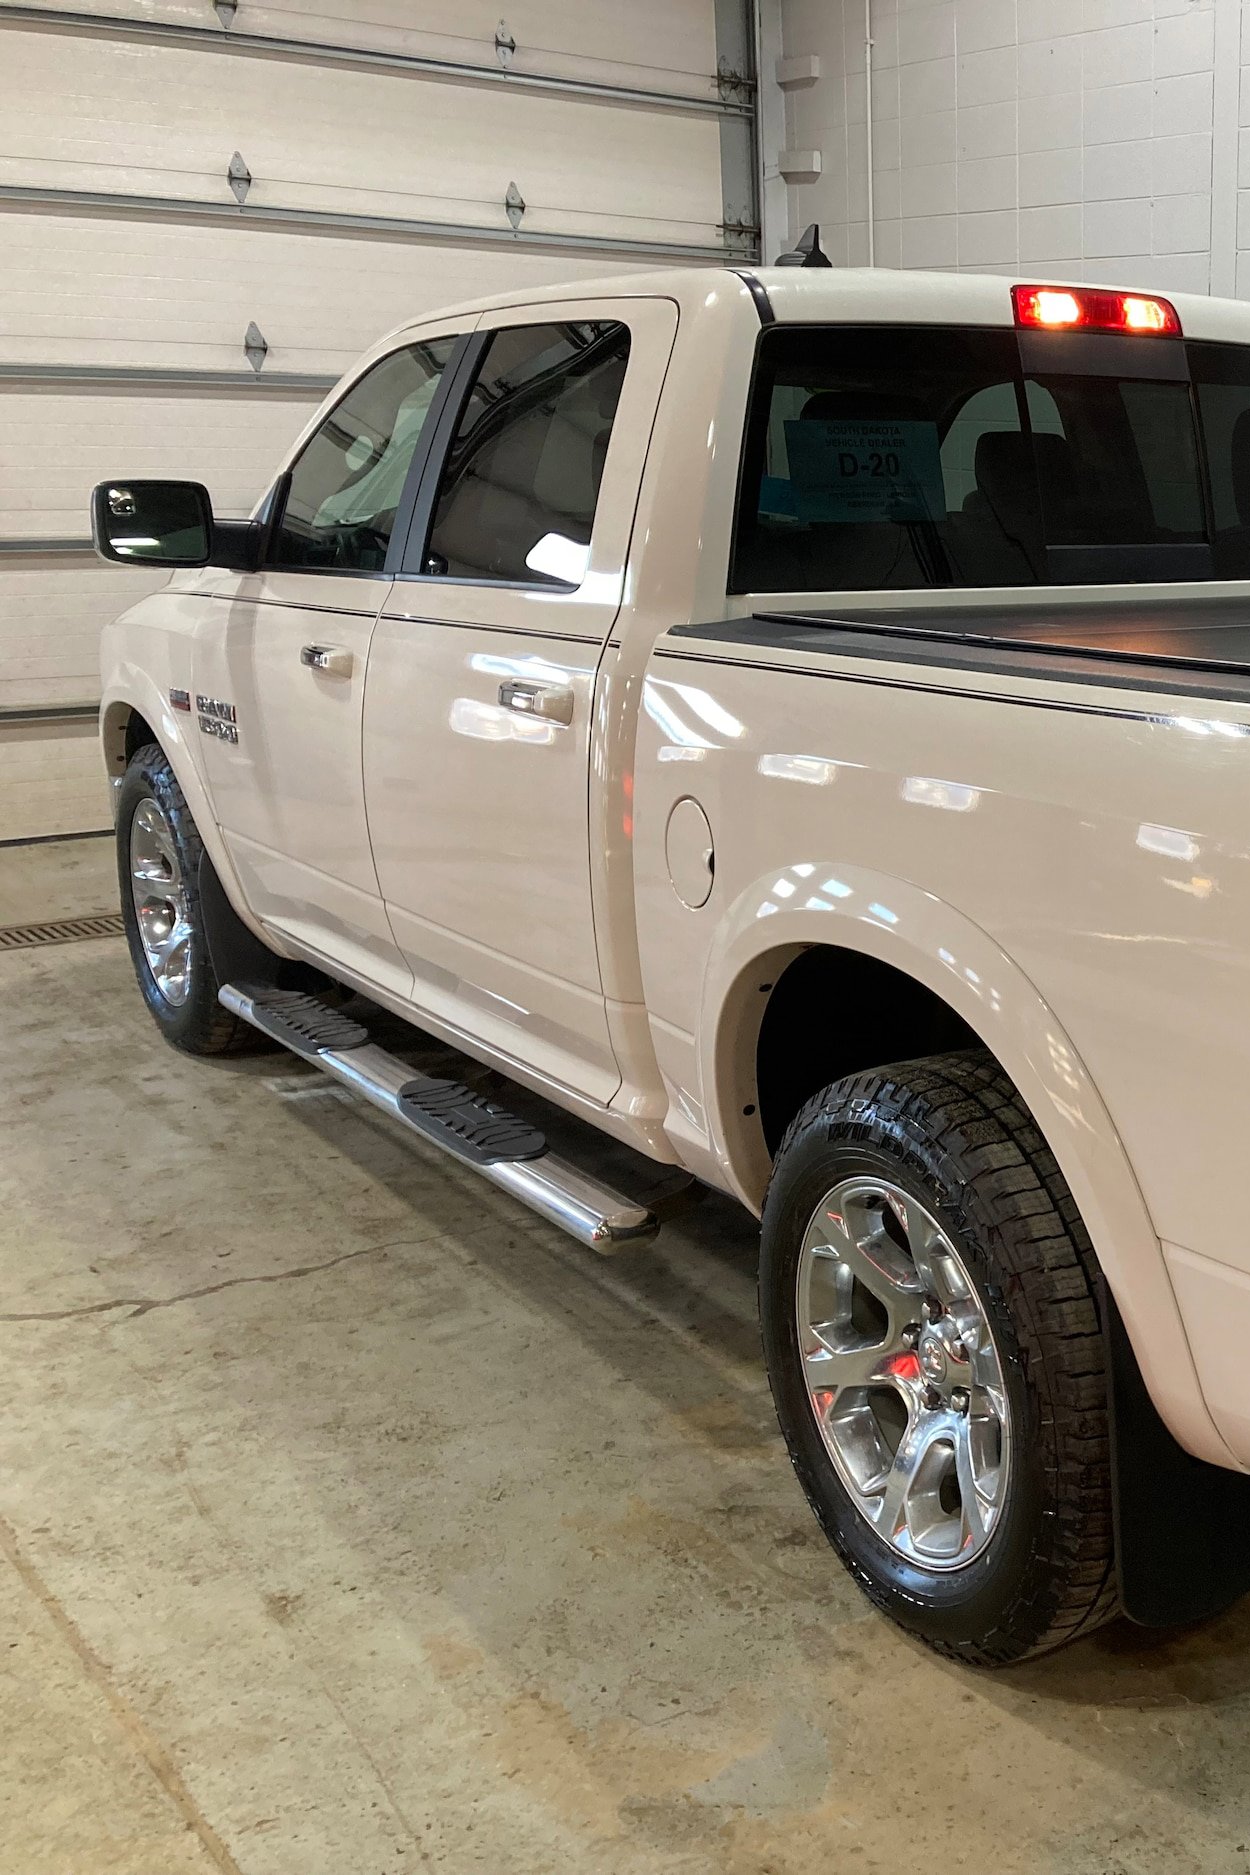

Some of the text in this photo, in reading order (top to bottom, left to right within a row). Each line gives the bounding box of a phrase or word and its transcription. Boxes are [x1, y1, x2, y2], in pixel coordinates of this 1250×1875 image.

[827, 425, 901, 435] SOUTH DAKOTA
[825, 438, 865, 448] VEHICLE
[838, 452, 900, 478] D-20
